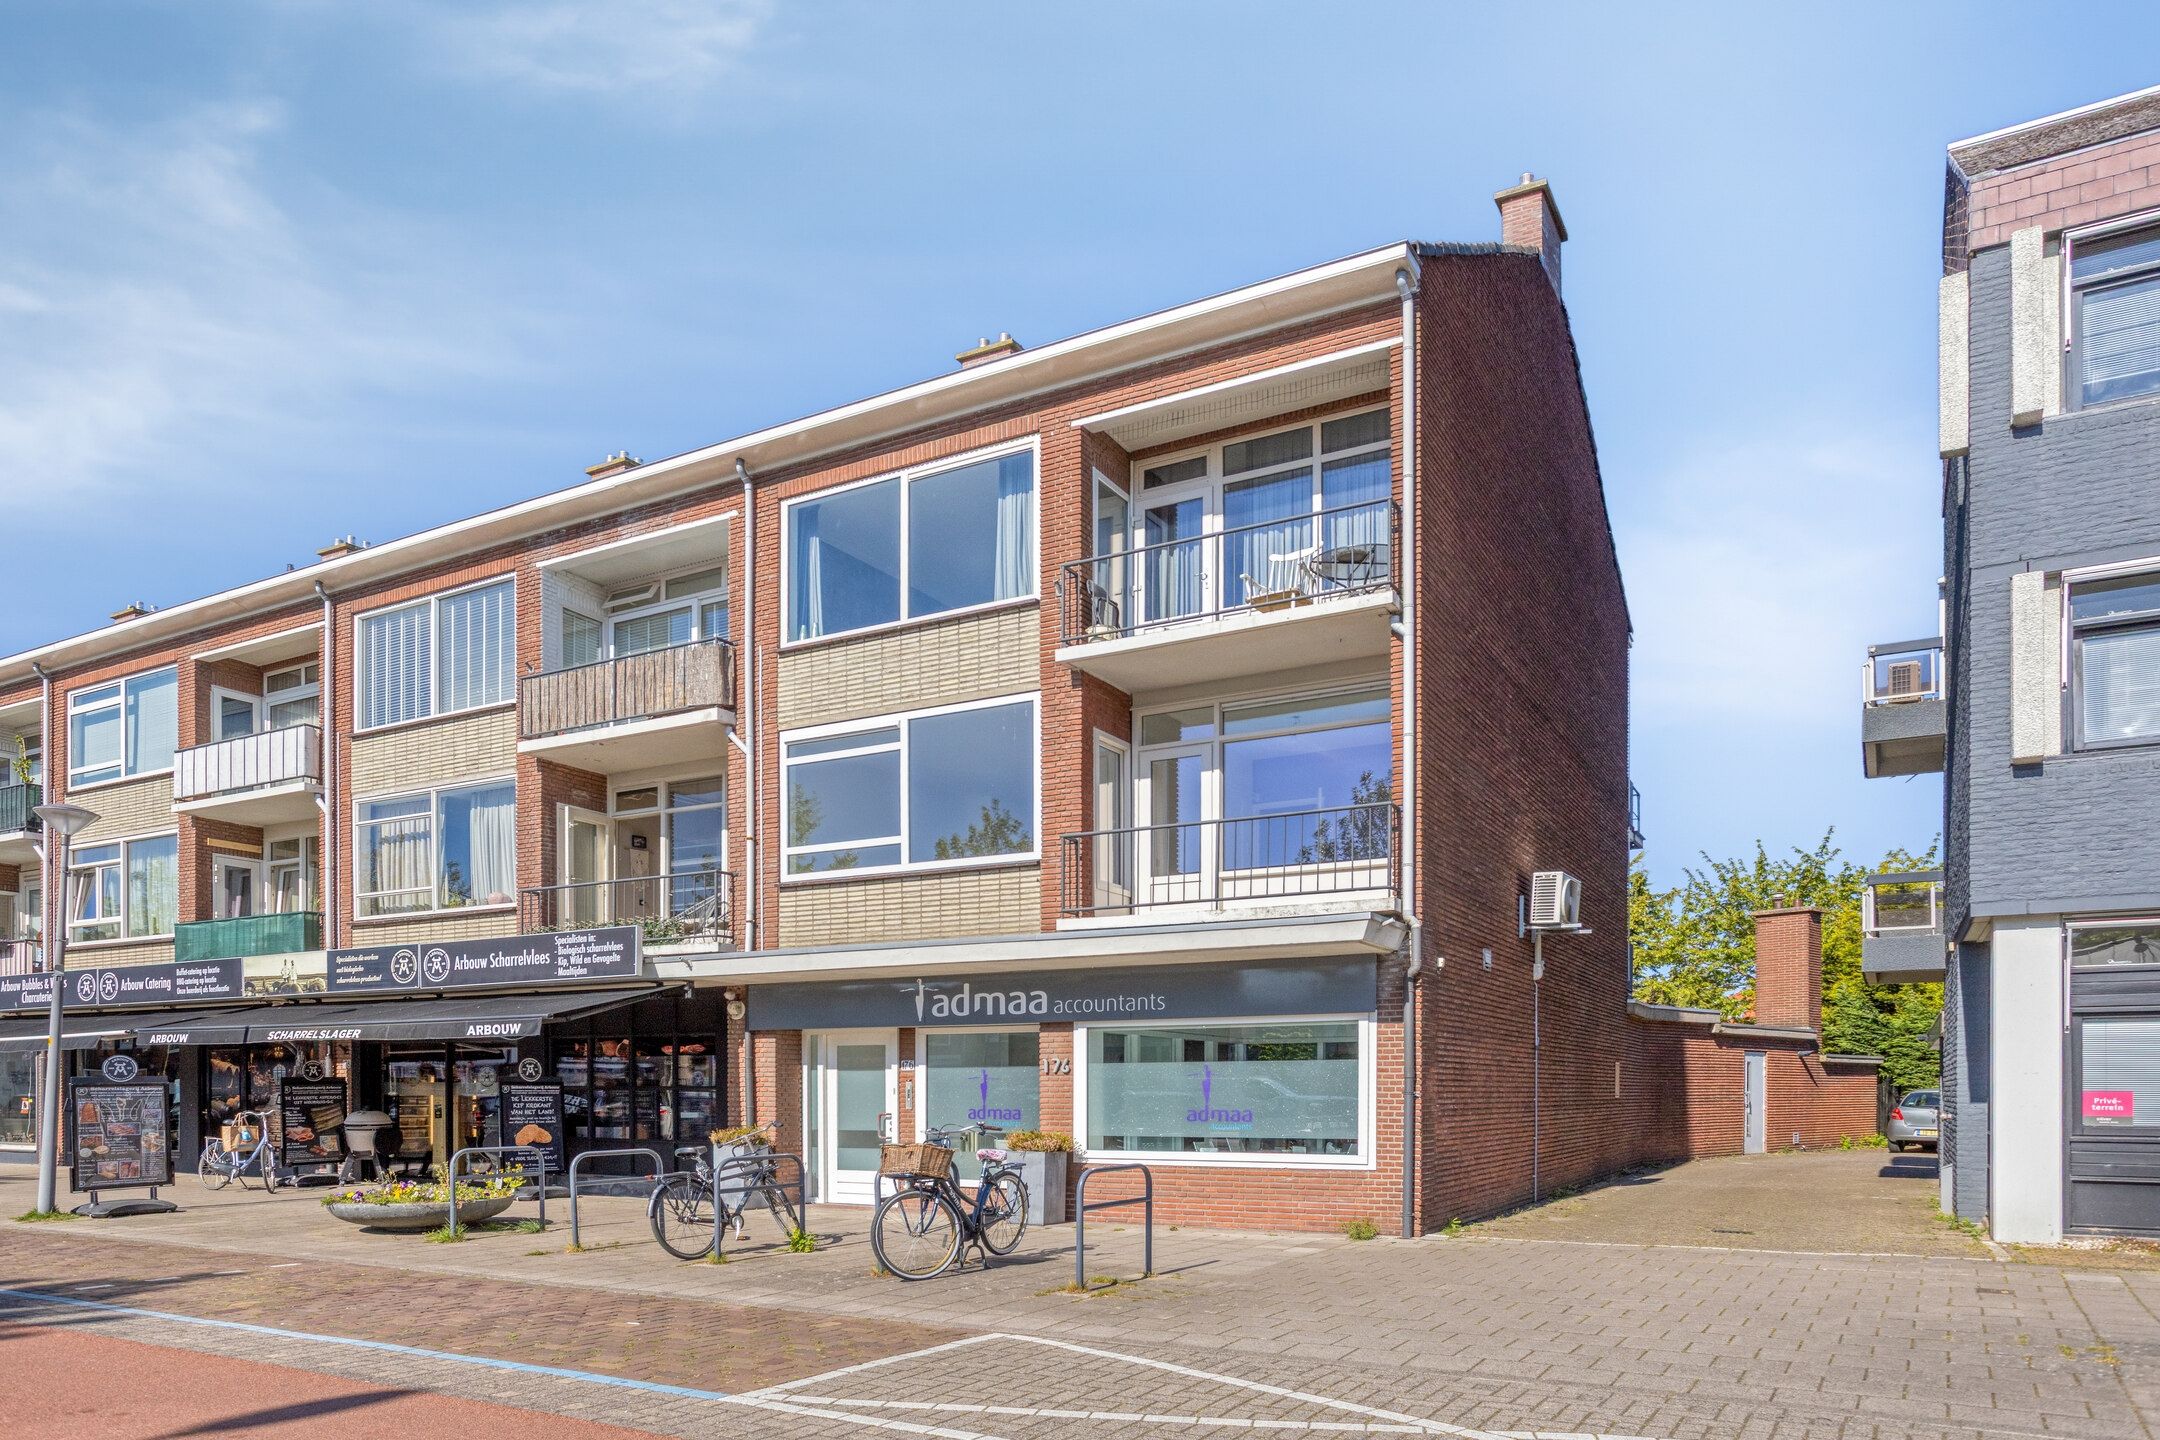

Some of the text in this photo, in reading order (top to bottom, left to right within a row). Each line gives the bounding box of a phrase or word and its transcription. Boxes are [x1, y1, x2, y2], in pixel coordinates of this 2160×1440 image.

[555, 934, 596, 946] Specialisten in:
[558, 943, 585, 956] Biologisch
[587, 941, 623, 953] scharrelvlees
[454, 948, 550, 970] Arbouw Scharrelvlees
[558, 956, 569, 967] Kip,
[570, 954, 583, 965] Wild
[584, 956, 591, 964] en
[592, 952, 621, 965] Gevogelte
[558, 965, 587, 977] Maaltijden
[1, 980, 21, 992] Arbouw
[22, 977, 44, 990] Bubbles
[44, 979, 49, 989] &
[121, 975, 172, 991] Arbouw Catering
[21, 991, 52, 1003] Charcuterie
[932, 983, 1166, 1018] admaa accountants
[267, 1029, 362, 1040] SCHARRELSLAGER
[466, 1023, 521, 1036] ARBOUW
[149, 1033, 189, 1044] ARBOUW
[901, 1061, 914, 1070] 176
[1041, 1058, 1071, 1075] 176
[968, 1107, 1021, 1120] admaa
[1186, 1108, 1253, 1122] admaa
